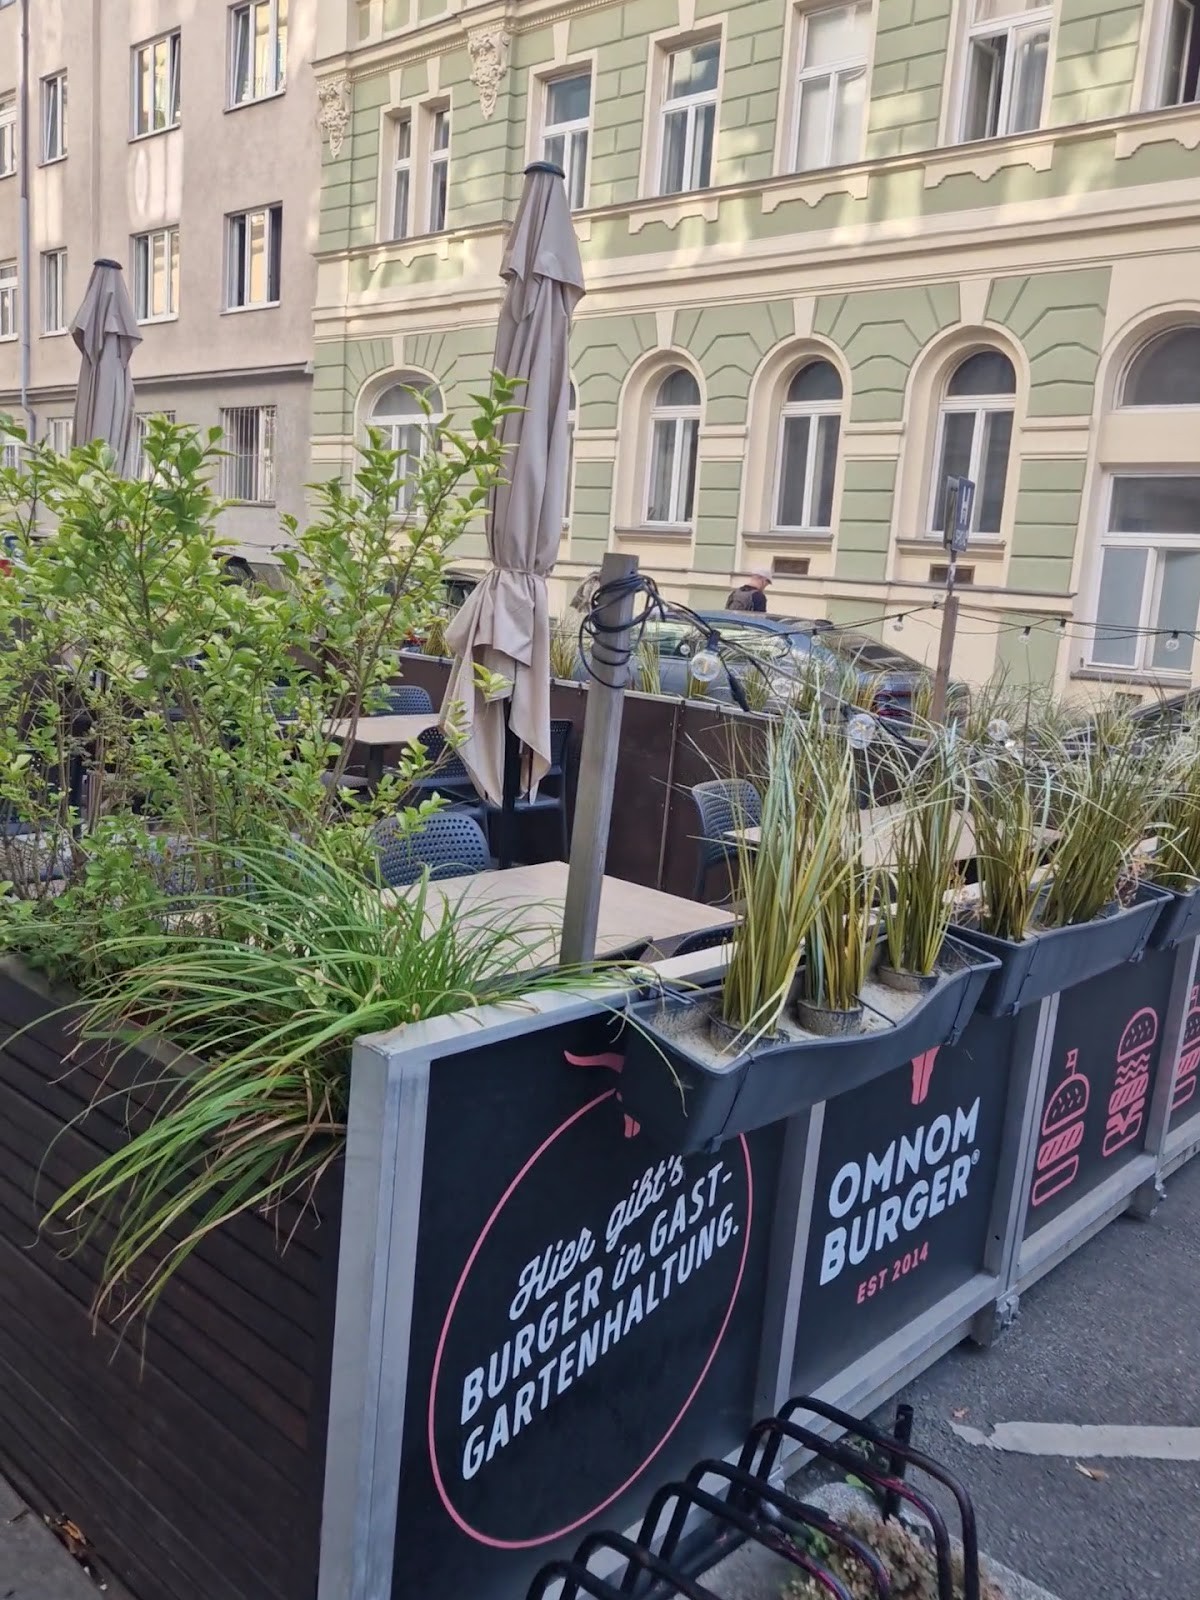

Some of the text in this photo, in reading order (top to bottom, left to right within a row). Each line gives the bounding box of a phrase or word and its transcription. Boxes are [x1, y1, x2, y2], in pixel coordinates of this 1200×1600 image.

[509, 1154, 684, 1320] Hier gibt's
[829, 1096, 981, 1219] OMNOM
[460, 1160, 733, 1425] BURGER in GAST-
[462, 1202, 740, 1480] GARTENHALTUNG.
[857, 1242, 928, 1304] EST 2014
